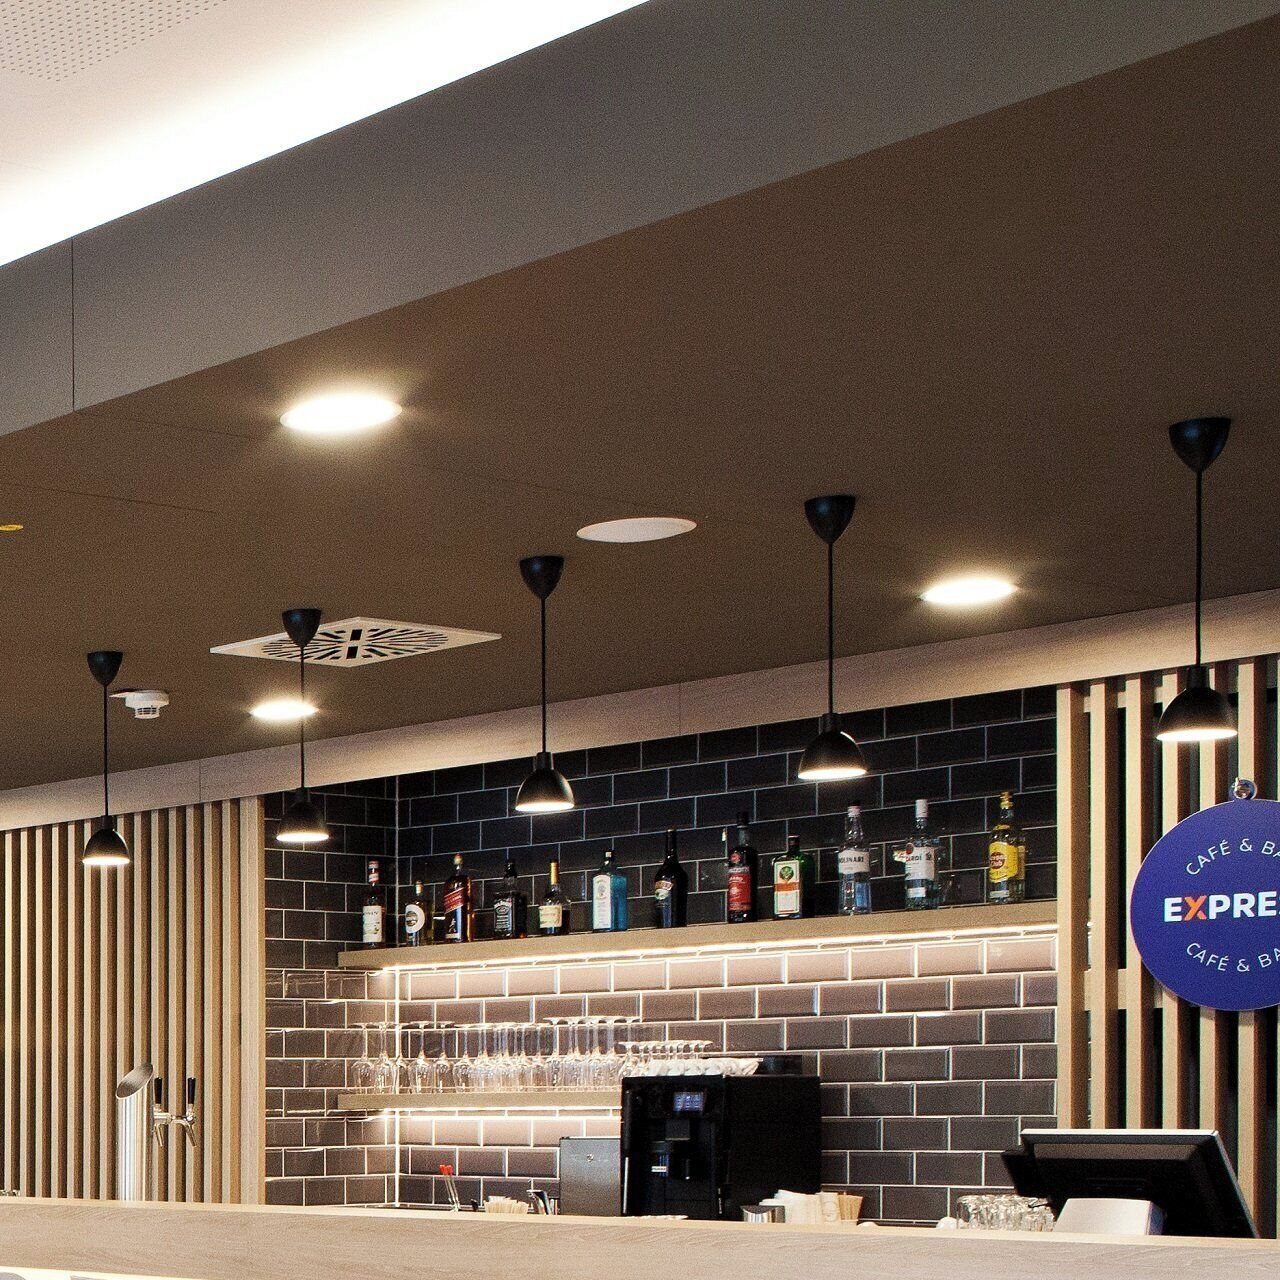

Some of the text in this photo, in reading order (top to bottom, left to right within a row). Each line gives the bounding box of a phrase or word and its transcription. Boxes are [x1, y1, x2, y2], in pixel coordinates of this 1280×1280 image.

[1186, 839, 1231, 875] CAFÉ
[1239, 838, 1253, 852] &
[1164, 891, 1280, 922] EXPRE
[1186, 942, 1230, 971] CAFÉ
[1236, 958, 1250, 972] &
